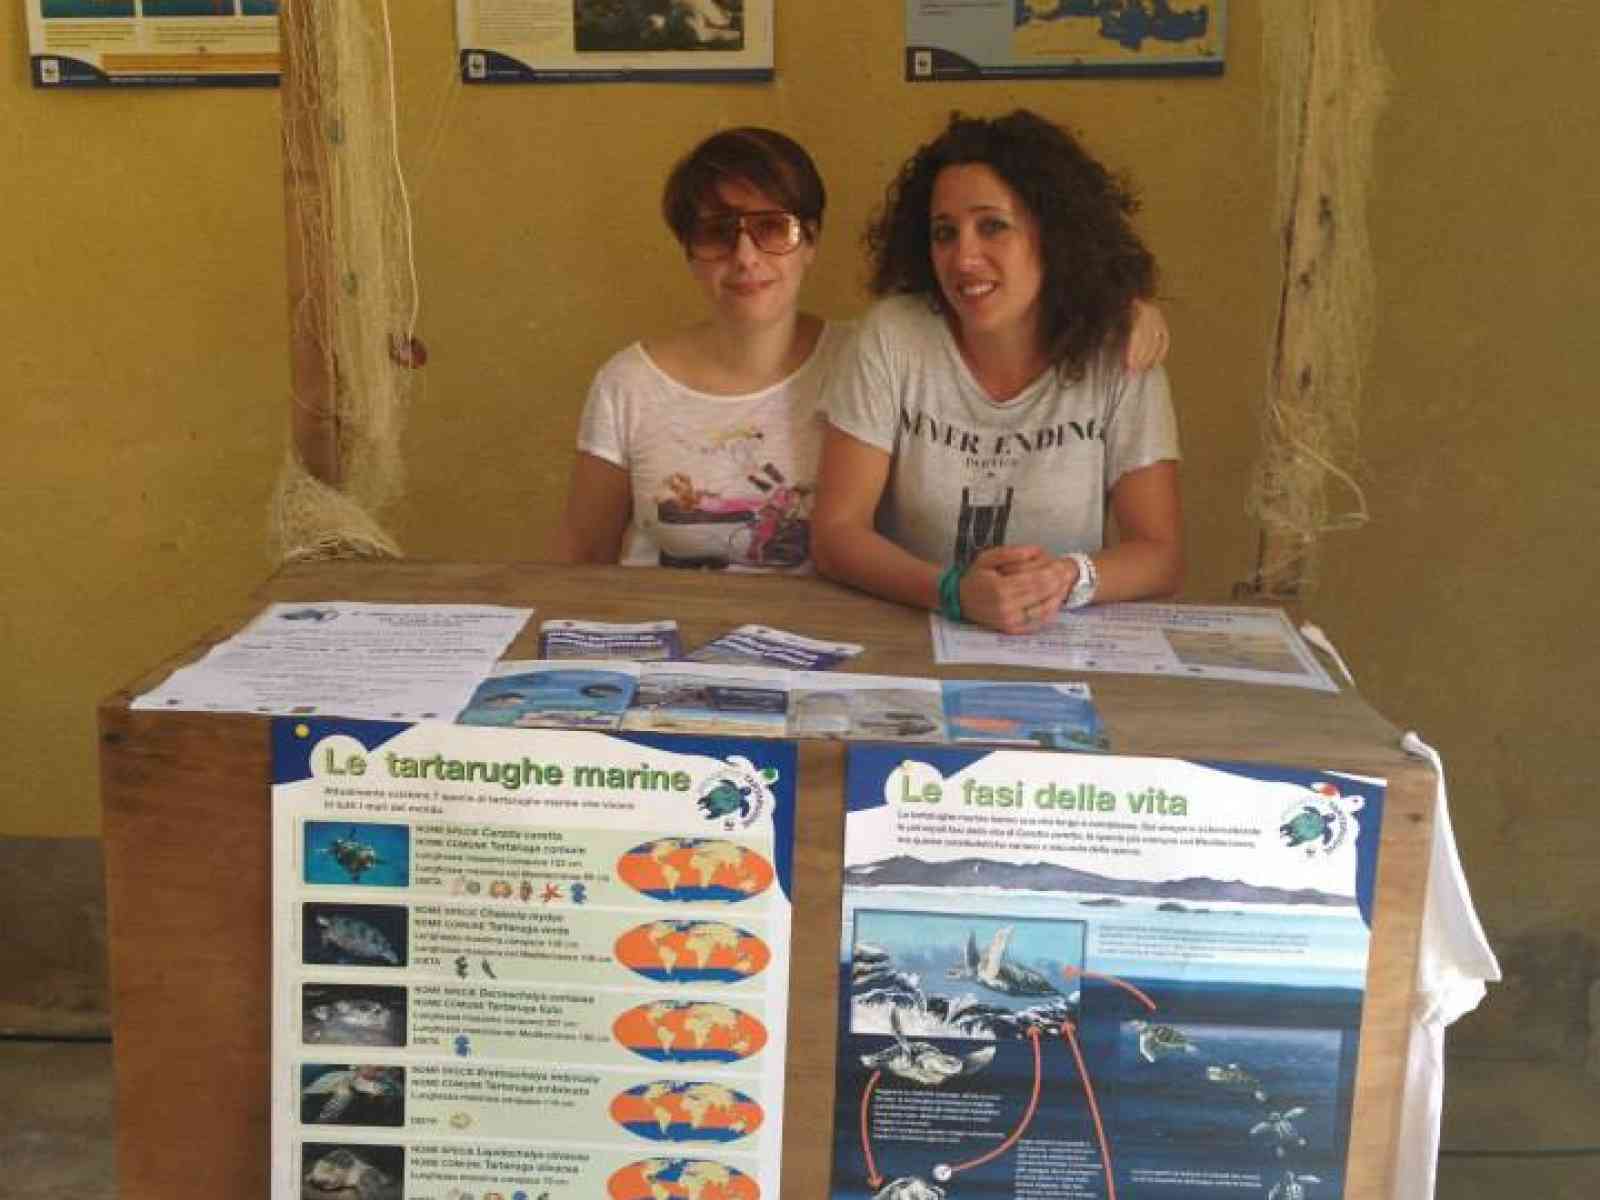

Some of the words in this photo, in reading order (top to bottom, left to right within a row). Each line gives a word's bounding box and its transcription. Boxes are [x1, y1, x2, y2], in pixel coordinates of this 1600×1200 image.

[899, 407, 978, 455] NEVER
[325, 746, 367, 777] Le
[385, 751, 562, 790] tartarughe
[572, 763, 691, 793] marine
[900, 774, 943, 804] Le
[962, 777, 1024, 808] fasi
[1034, 781, 1117, 812] della
[1127, 786, 1188, 816] vita
